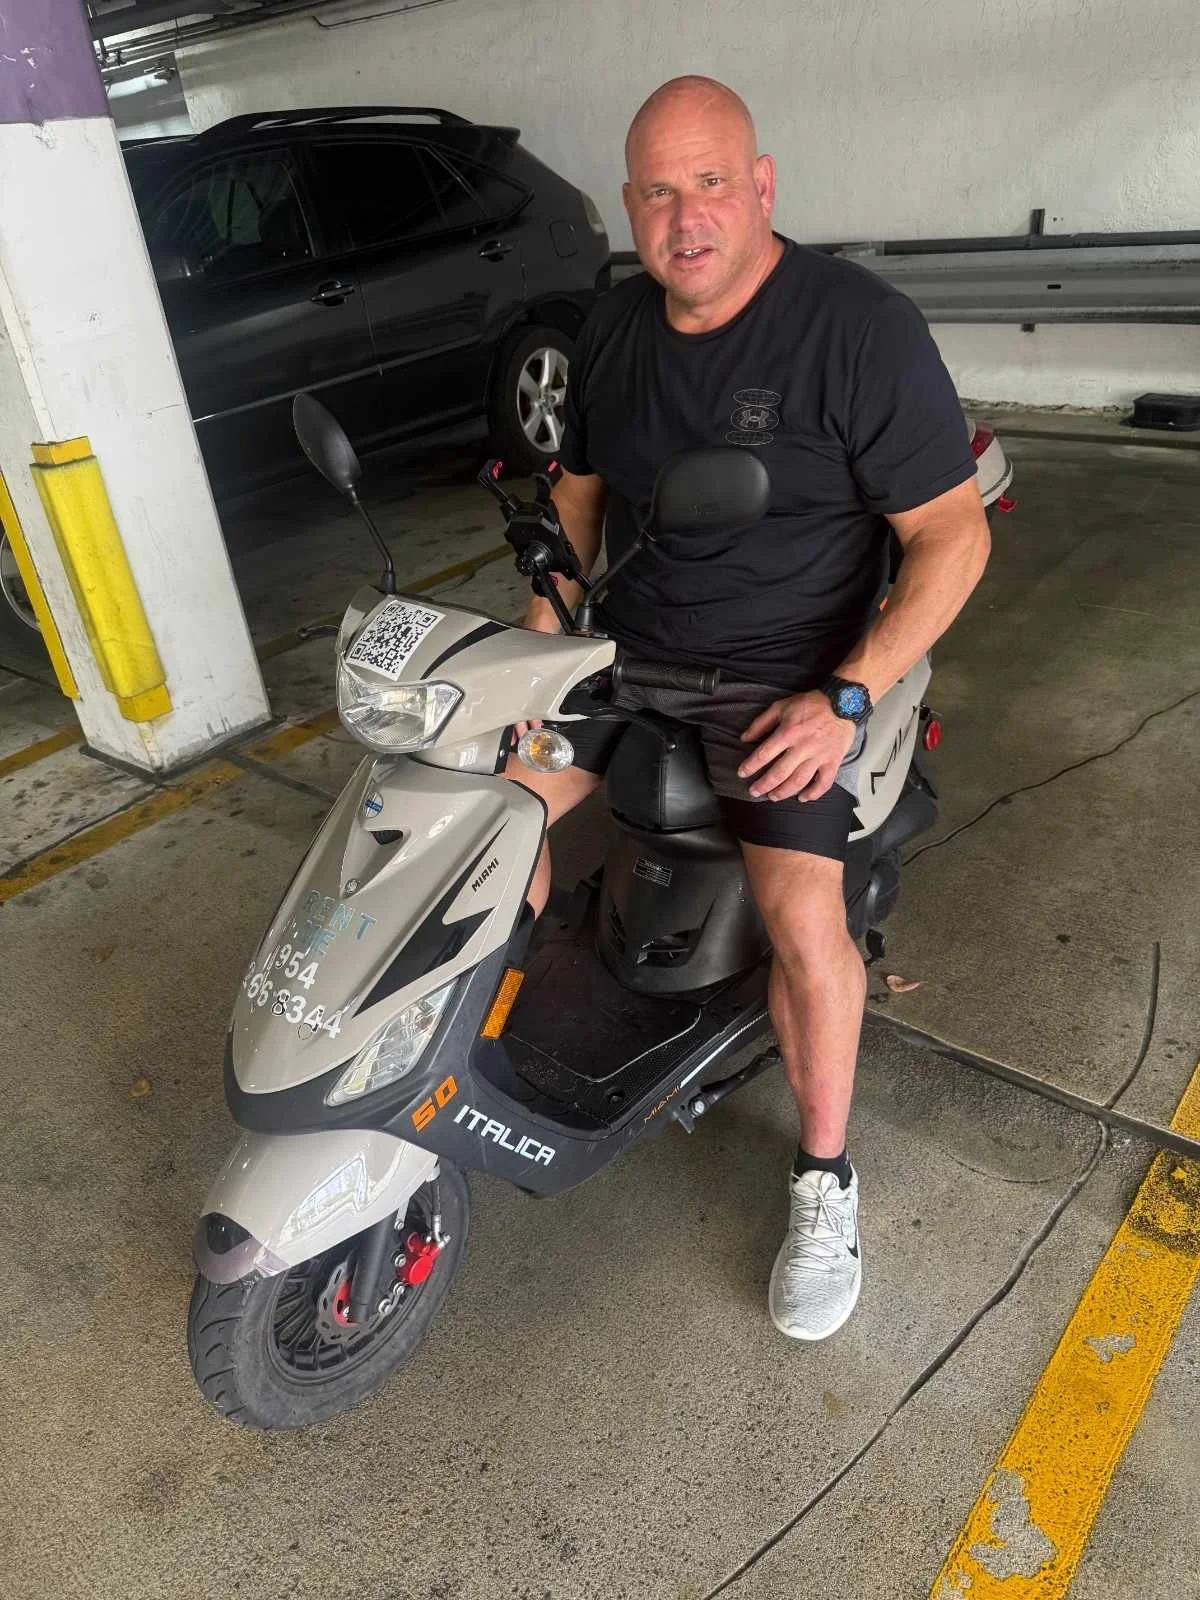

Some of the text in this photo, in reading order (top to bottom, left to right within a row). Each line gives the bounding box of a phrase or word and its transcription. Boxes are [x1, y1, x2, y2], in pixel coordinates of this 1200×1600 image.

[471, 857, 499, 892] MIAMI
[274, 943, 320, 990] 954
[271, 988, 344, 1039] 8344
[411, 1075, 458, 1132] 50
[453, 1104, 556, 1166] ITALICA
